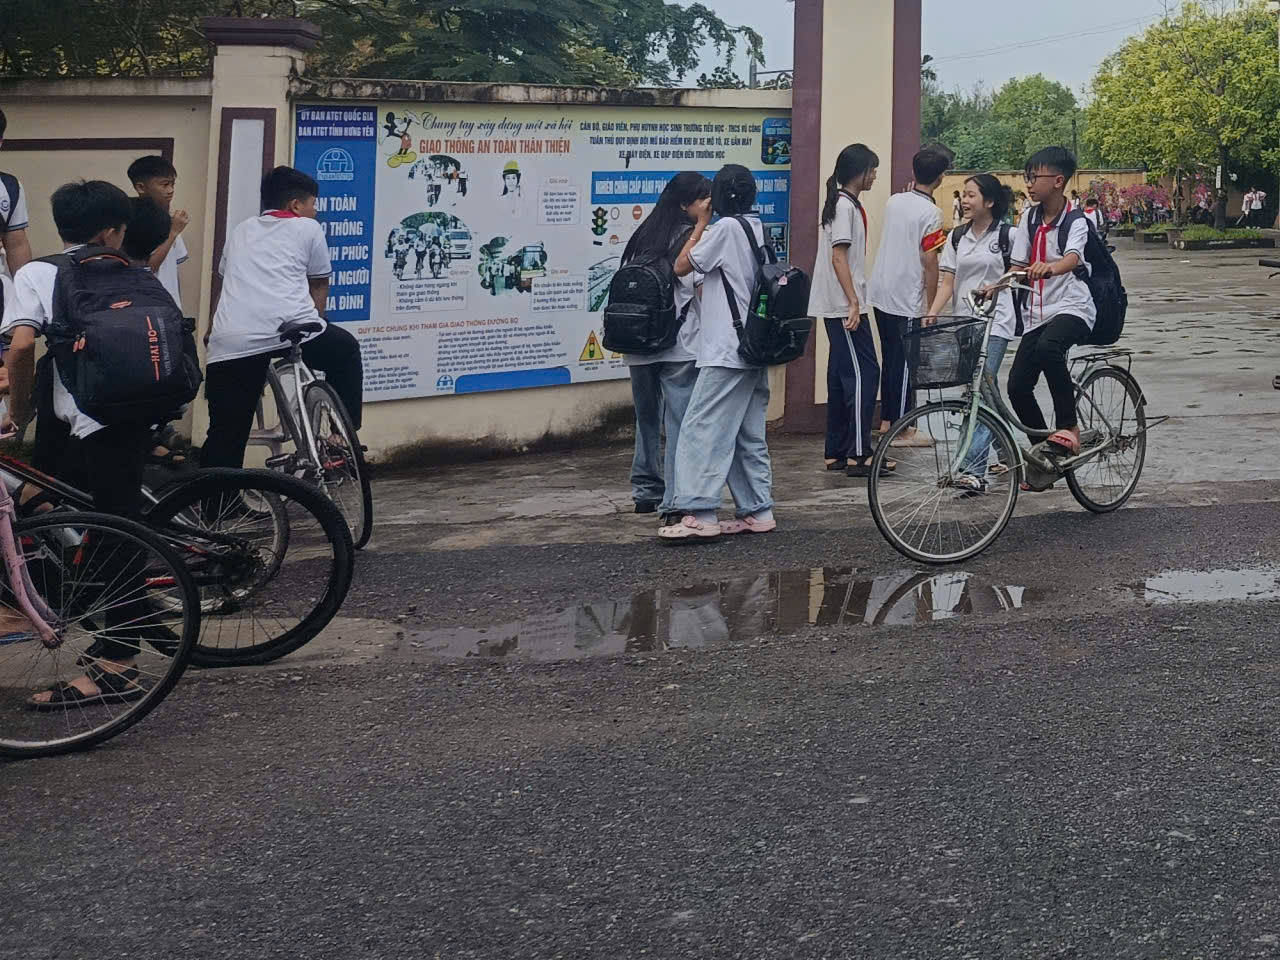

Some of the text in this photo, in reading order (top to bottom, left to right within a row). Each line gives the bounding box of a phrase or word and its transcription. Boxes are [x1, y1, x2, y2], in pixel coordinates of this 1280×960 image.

[421, 112, 573, 138] Chung tay xây dựng một xã hội
[419, 137, 570, 156] GIAO THÔNG AN TOÀN THÂN THIỆN
[330, 194, 357, 211] TOÀN
[330, 219, 364, 236] THÔNG
[341, 242, 369, 260] PHÚC
[338, 267, 370, 286] NGƯỜI
[338, 292, 364, 310] ĐÌNH
